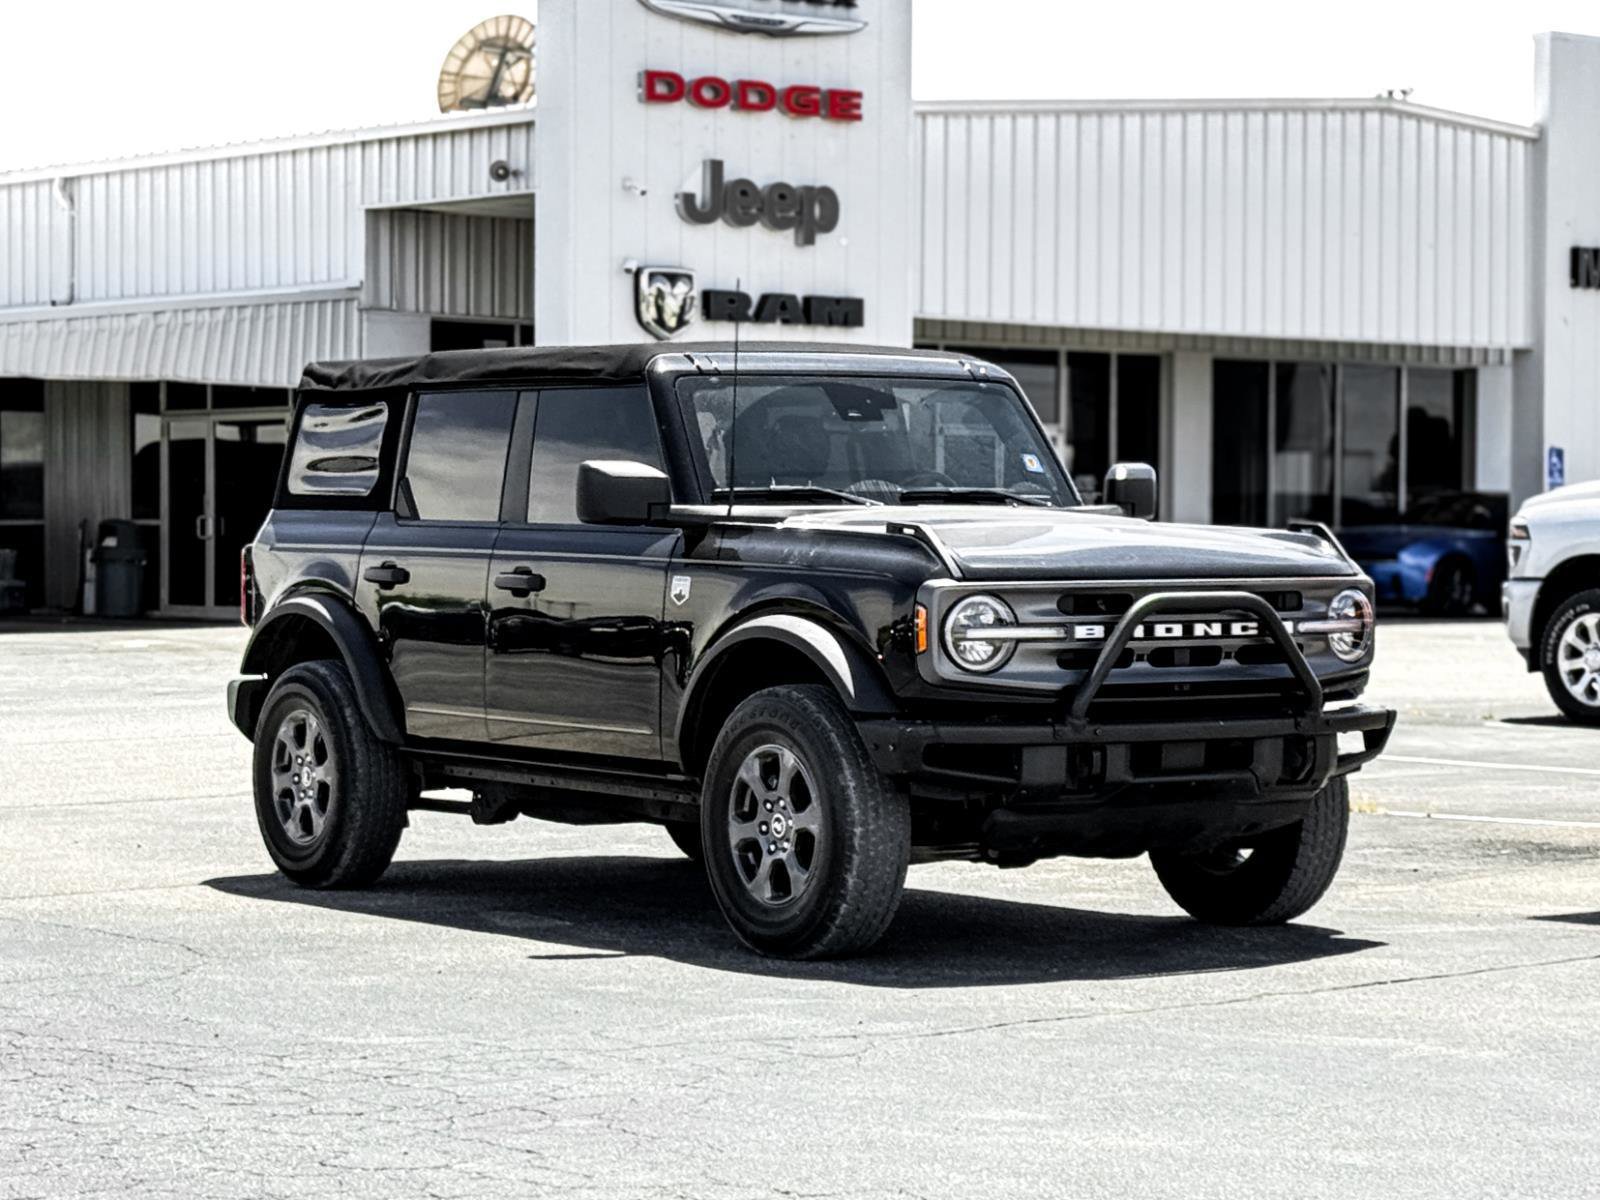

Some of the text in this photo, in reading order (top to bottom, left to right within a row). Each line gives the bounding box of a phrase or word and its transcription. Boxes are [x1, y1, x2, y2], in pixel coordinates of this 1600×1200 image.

[638, 69, 863, 121] DODGE
[675, 159, 840, 247] Jeep
[701, 289, 864, 327] RAM
[1074, 620, 1294, 639] BONC
